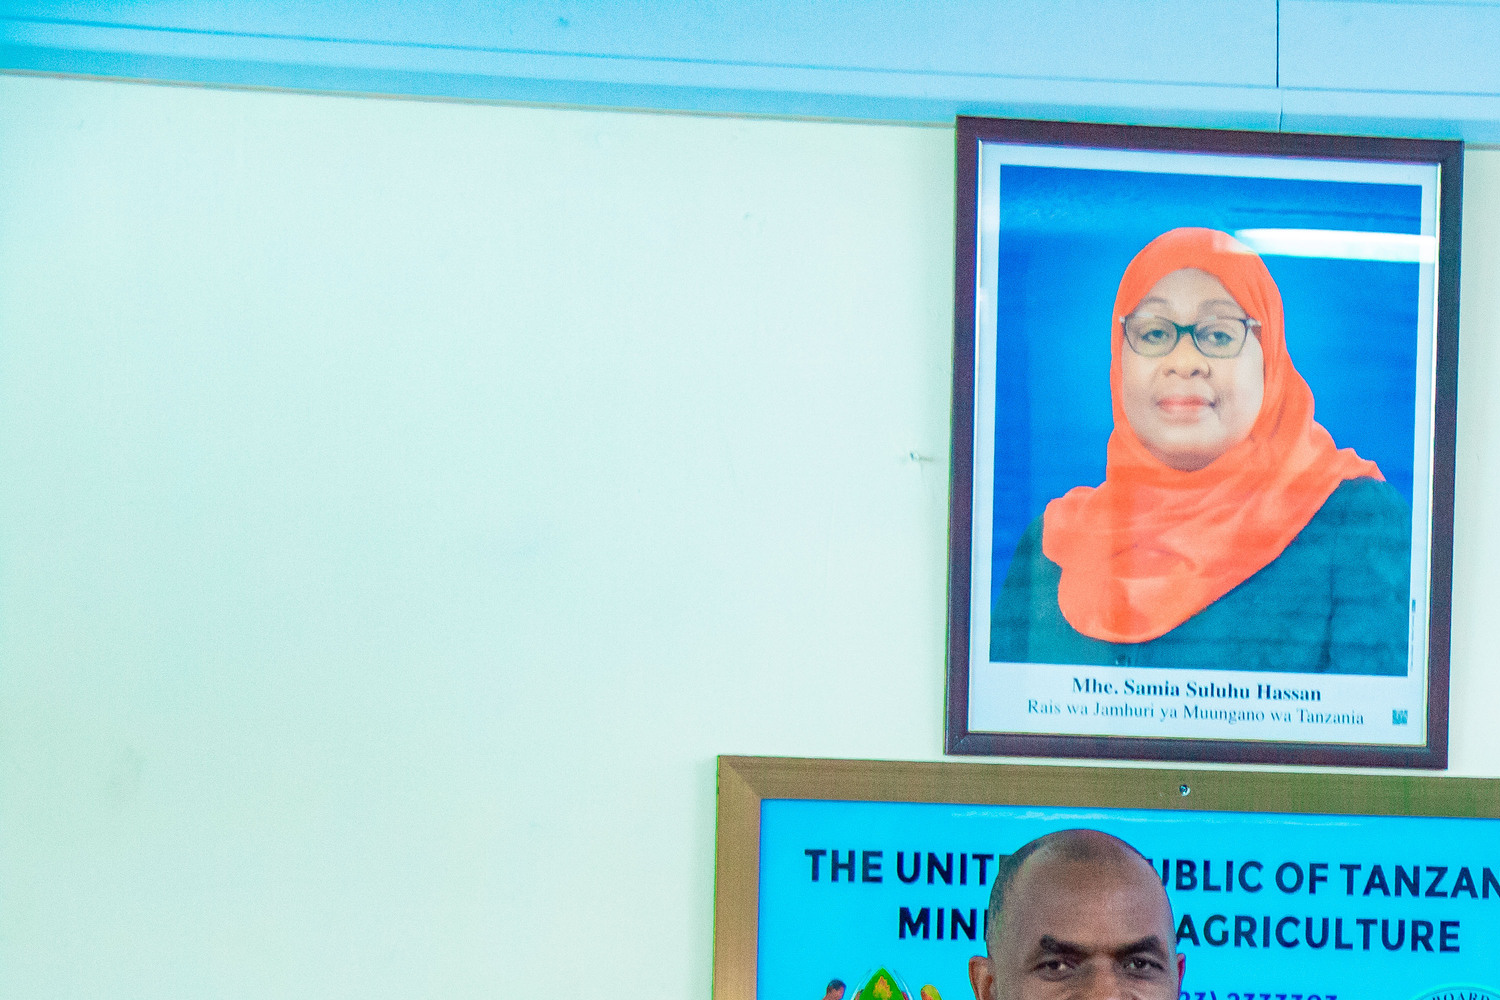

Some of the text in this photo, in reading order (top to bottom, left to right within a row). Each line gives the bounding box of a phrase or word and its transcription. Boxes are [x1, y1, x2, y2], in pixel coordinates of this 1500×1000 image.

[1072, 677, 1322, 701] Mhe. Samia Suluhu Hassan
[1028, 699, 1364, 725] Rais wa Jamhuri ya Muungano wa Tanzania
[804, 848, 884, 884] THE
[896, 851, 995, 887] UNIT
[1146, 858, 1265, 892] UBLIC
[1274, 861, 1329, 895] OF
[1176, 914, 1461, 953] AGRICULTURE
